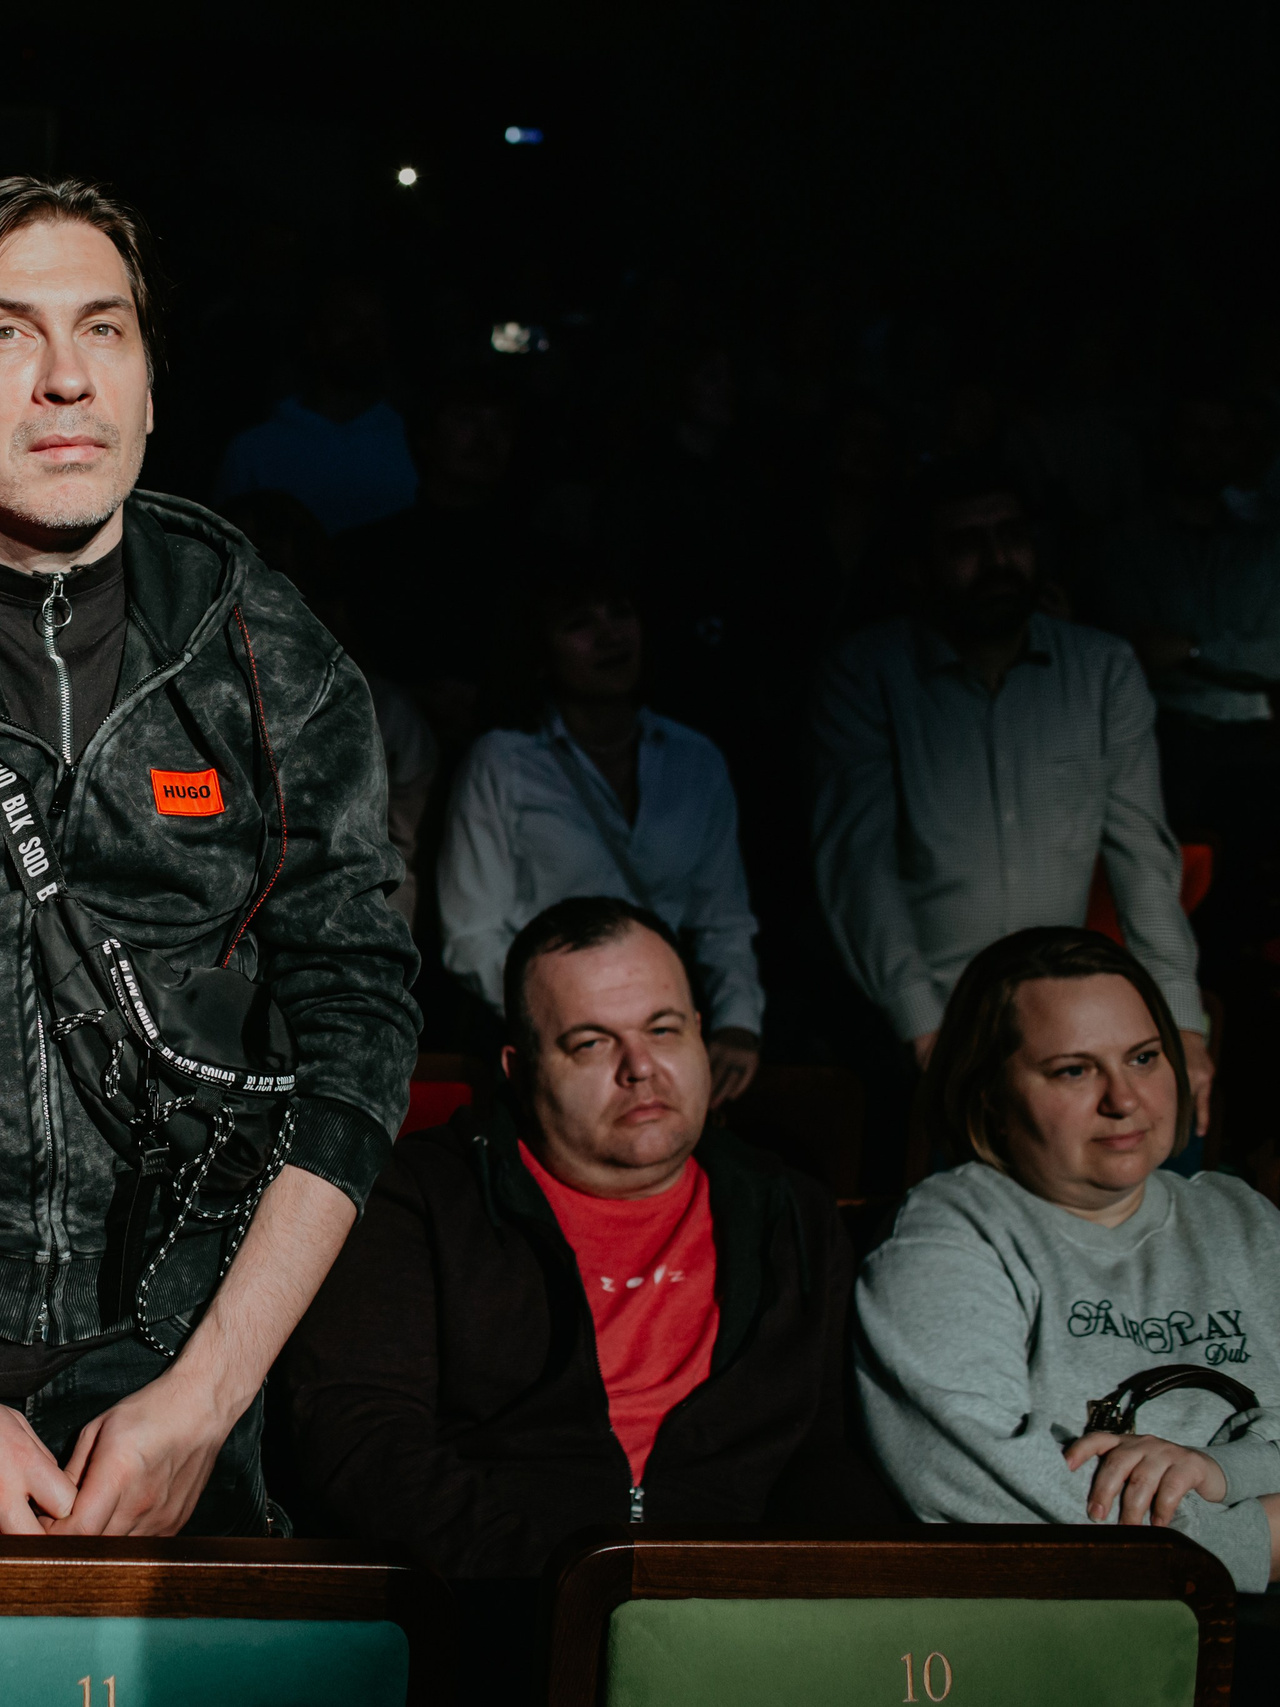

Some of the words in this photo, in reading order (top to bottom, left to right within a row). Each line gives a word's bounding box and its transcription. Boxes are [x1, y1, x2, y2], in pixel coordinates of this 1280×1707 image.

[163, 785, 211, 798] HUGO
[1, 793, 35, 835] BLK
[18, 836, 49, 878] SQD
[77, 1675, 116, 1707] 11
[901, 1652, 952, 1702] 10
